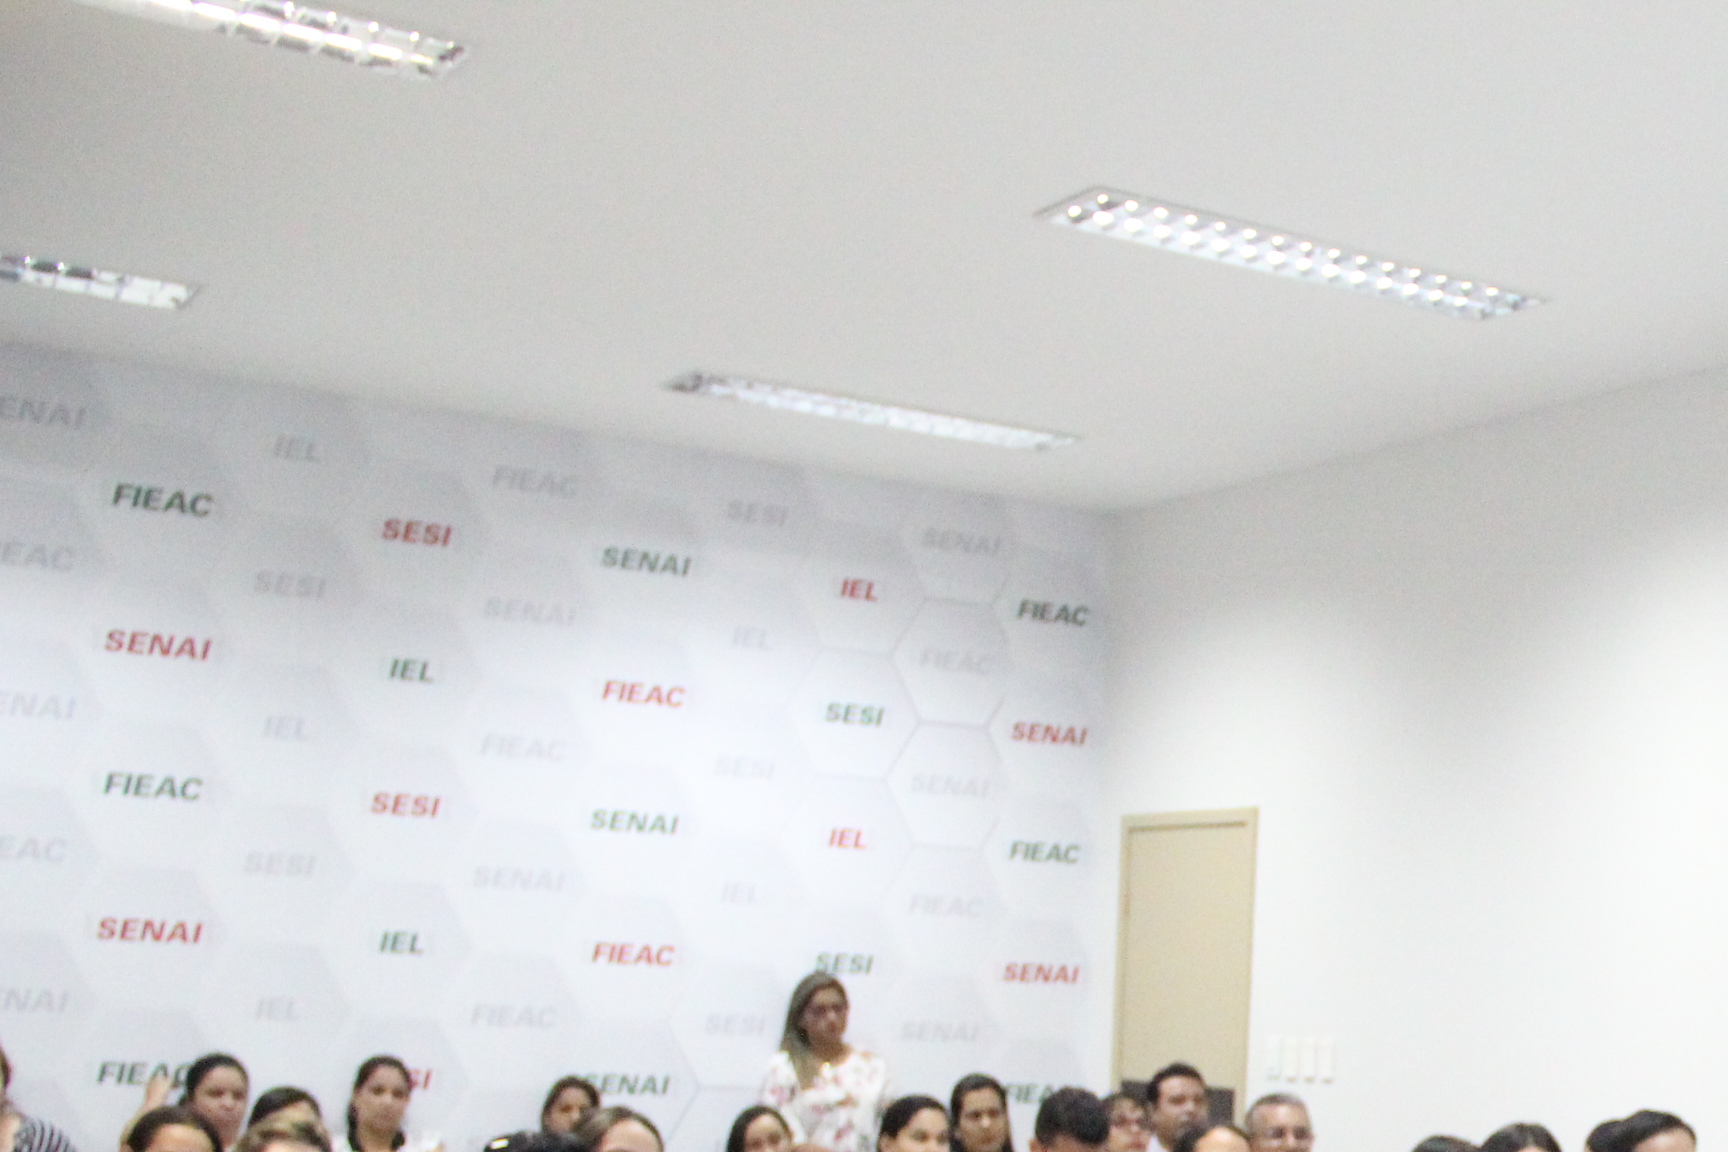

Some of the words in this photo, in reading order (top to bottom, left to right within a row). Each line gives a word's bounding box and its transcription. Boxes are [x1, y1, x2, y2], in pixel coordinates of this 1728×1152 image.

[0, 396, 86, 430] ENAI
[112, 482, 215, 517] FIEAC
[381, 517, 453, 547] SESI
[601, 546, 692, 578] SENAI
[840, 578, 879, 603] IEL
[1017, 599, 1089, 628] FIEAC
[104, 629, 213, 661] SENAI
[389, 658, 435, 683] IEL
[602, 680, 687, 709] FIEAC
[825, 702, 885, 727] SESI
[1011, 721, 1089, 747] SENAI
[103, 771, 203, 802] FIEAC
[370, 792, 442, 818] SESI
[590, 808, 680, 836] SENAI
[828, 828, 868, 850] IEL
[1009, 840, 1082, 864] FIEAC
[97, 918, 204, 944] SENAI
[378, 930, 425, 955] IEL
[591, 941, 676, 967] FIEAC
[816, 952, 874, 975] SESI
[1002, 962, 1080, 985] SENAI
